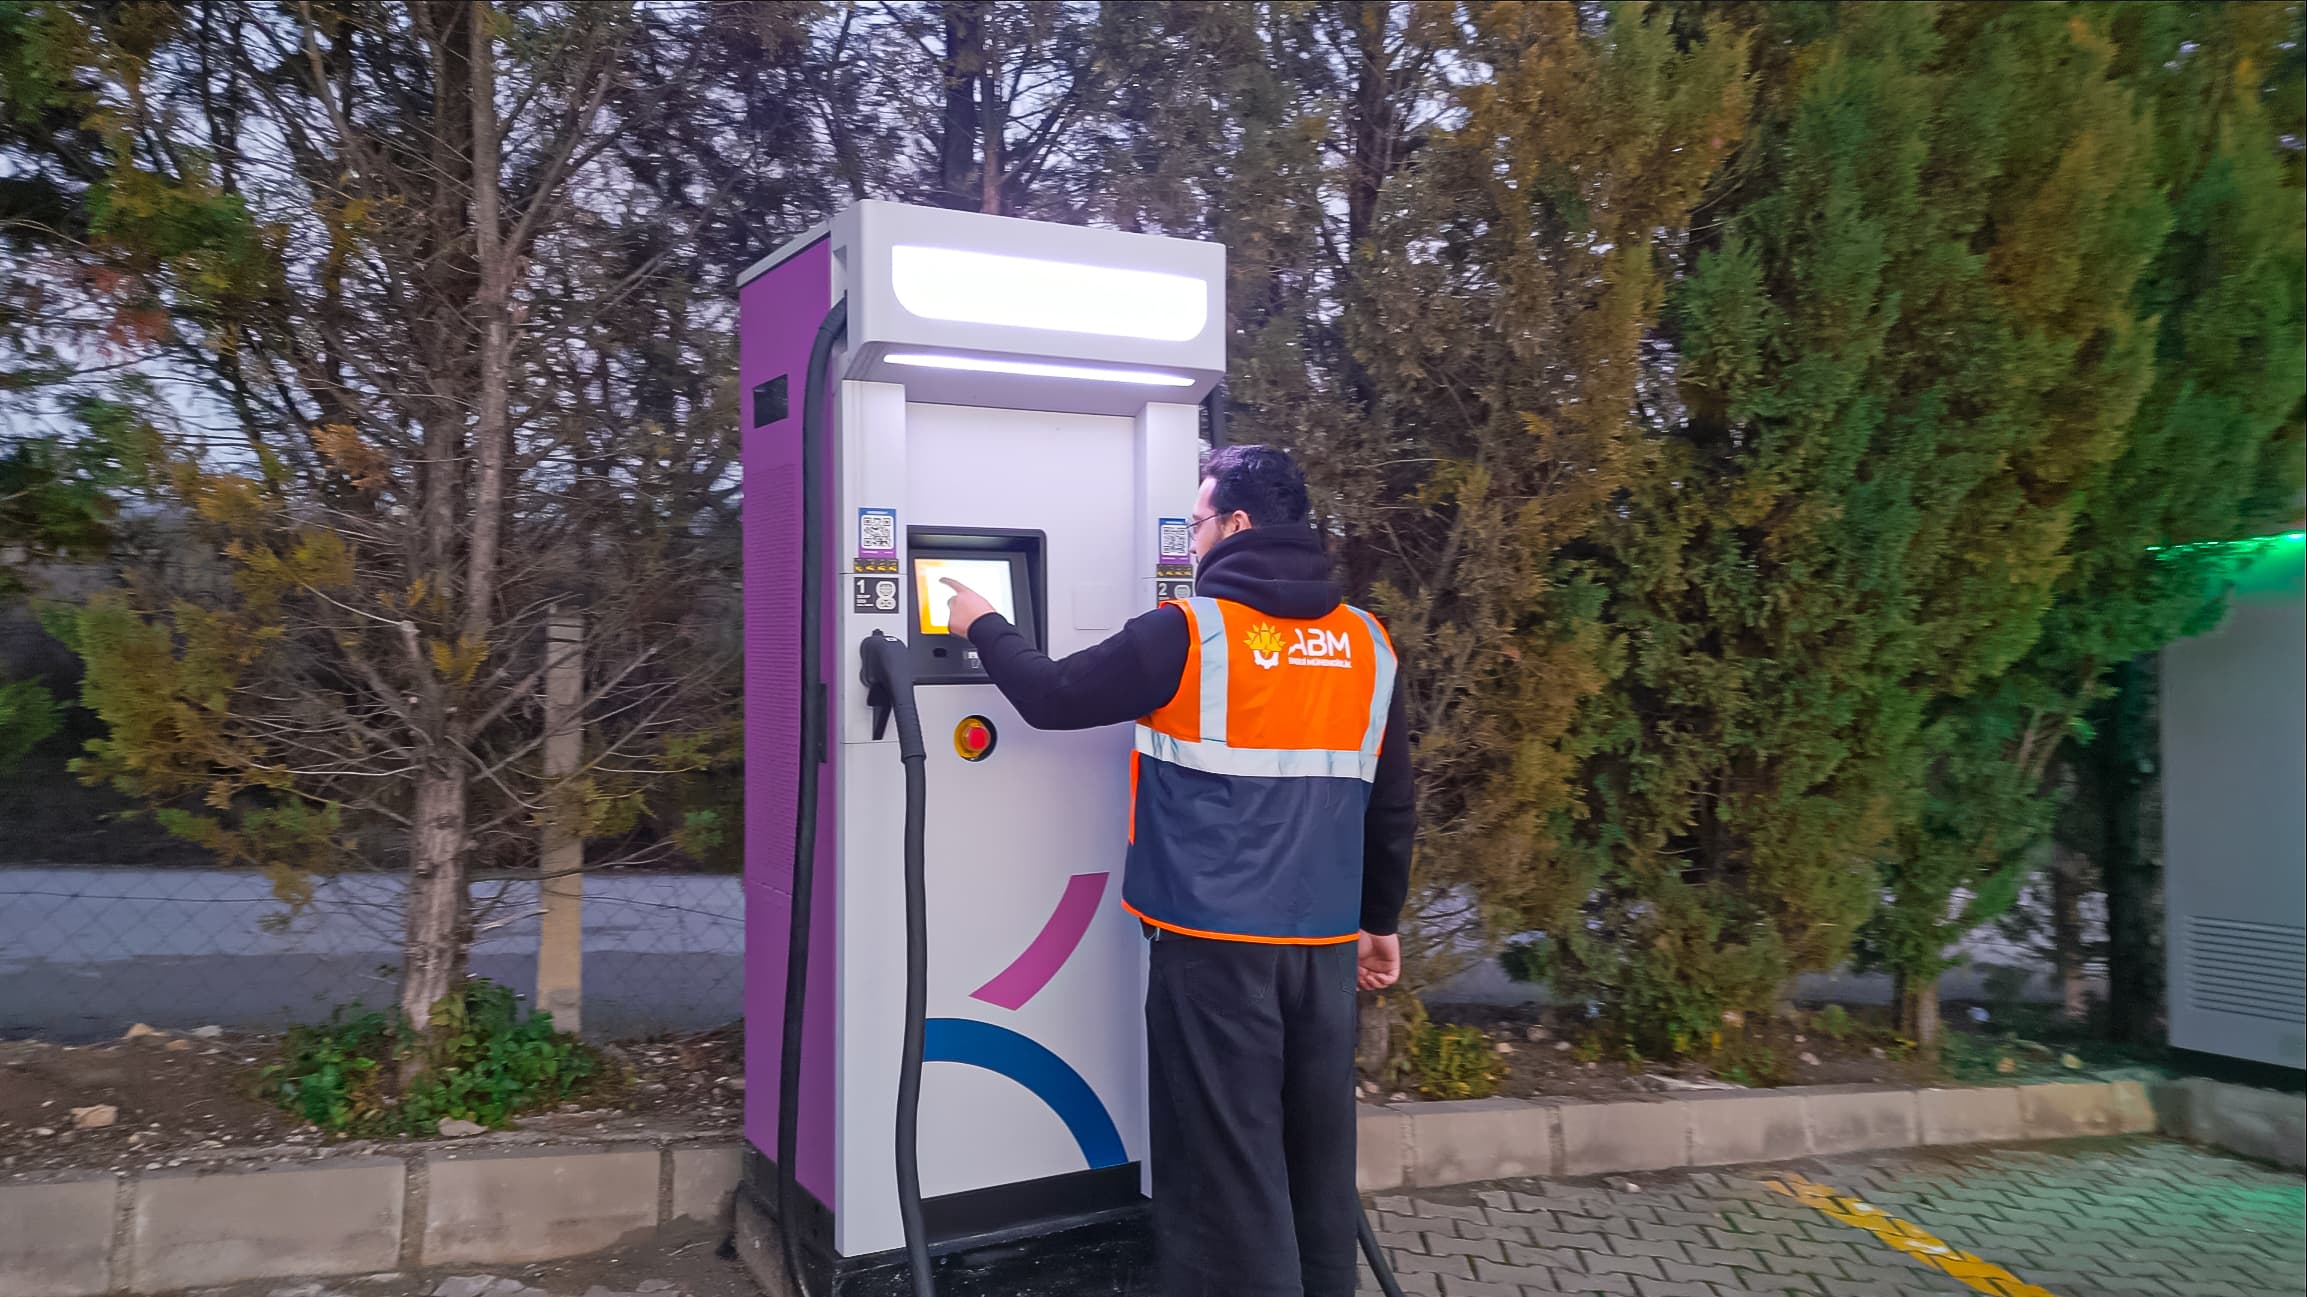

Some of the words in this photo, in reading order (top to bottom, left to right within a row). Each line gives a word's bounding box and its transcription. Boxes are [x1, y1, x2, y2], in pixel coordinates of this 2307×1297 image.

[856, 579, 865, 594] 1
[1158, 582, 1168, 596] 2
[1287, 627, 1351, 659] ABM
